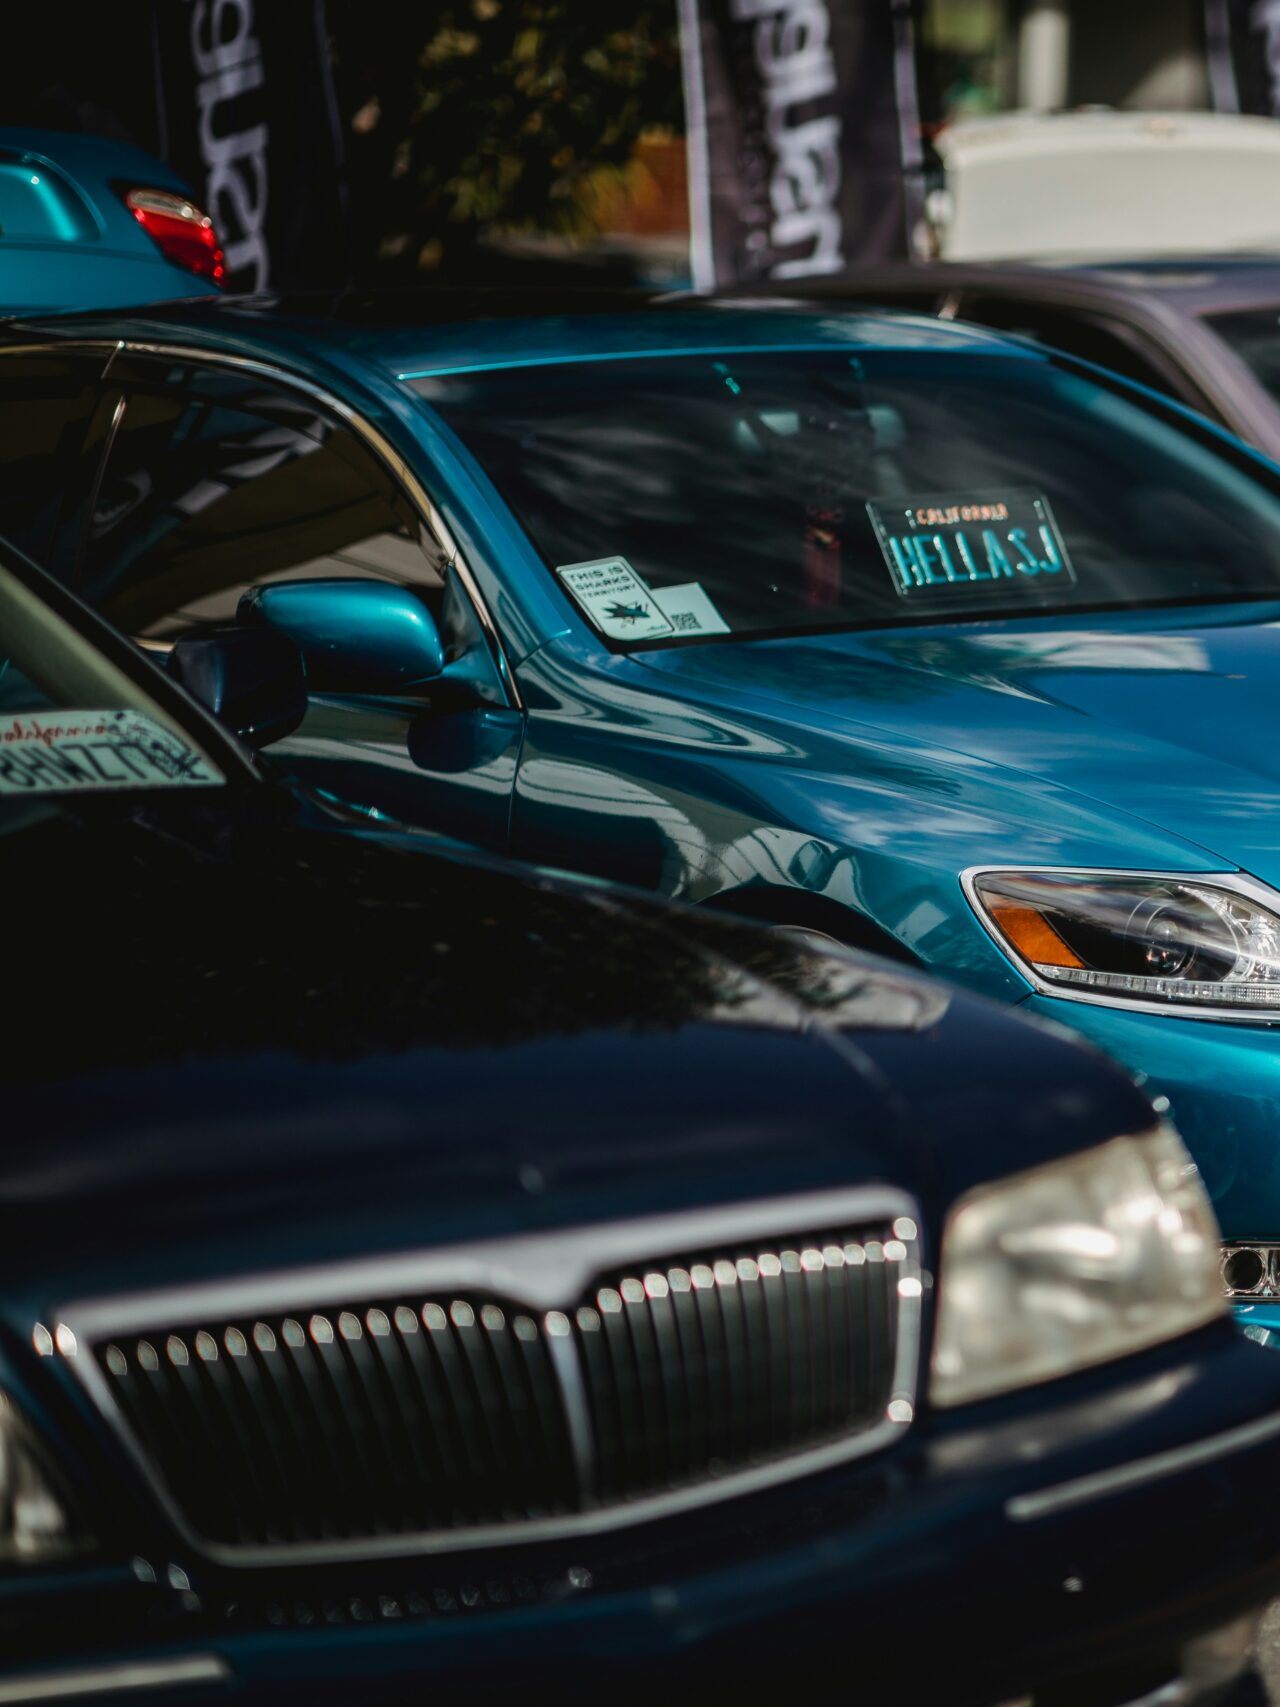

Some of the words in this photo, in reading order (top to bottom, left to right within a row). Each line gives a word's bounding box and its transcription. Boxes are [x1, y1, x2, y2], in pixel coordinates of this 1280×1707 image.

[916, 503, 1009, 525] CALIFORNIA
[568, 569, 604, 582] THIS
[609, 565, 625, 575] IS
[574, 575, 631, 591] SHARKS
[582, 583, 636, 598] TERRITORY
[0, 720, 106, 746] alifornia
